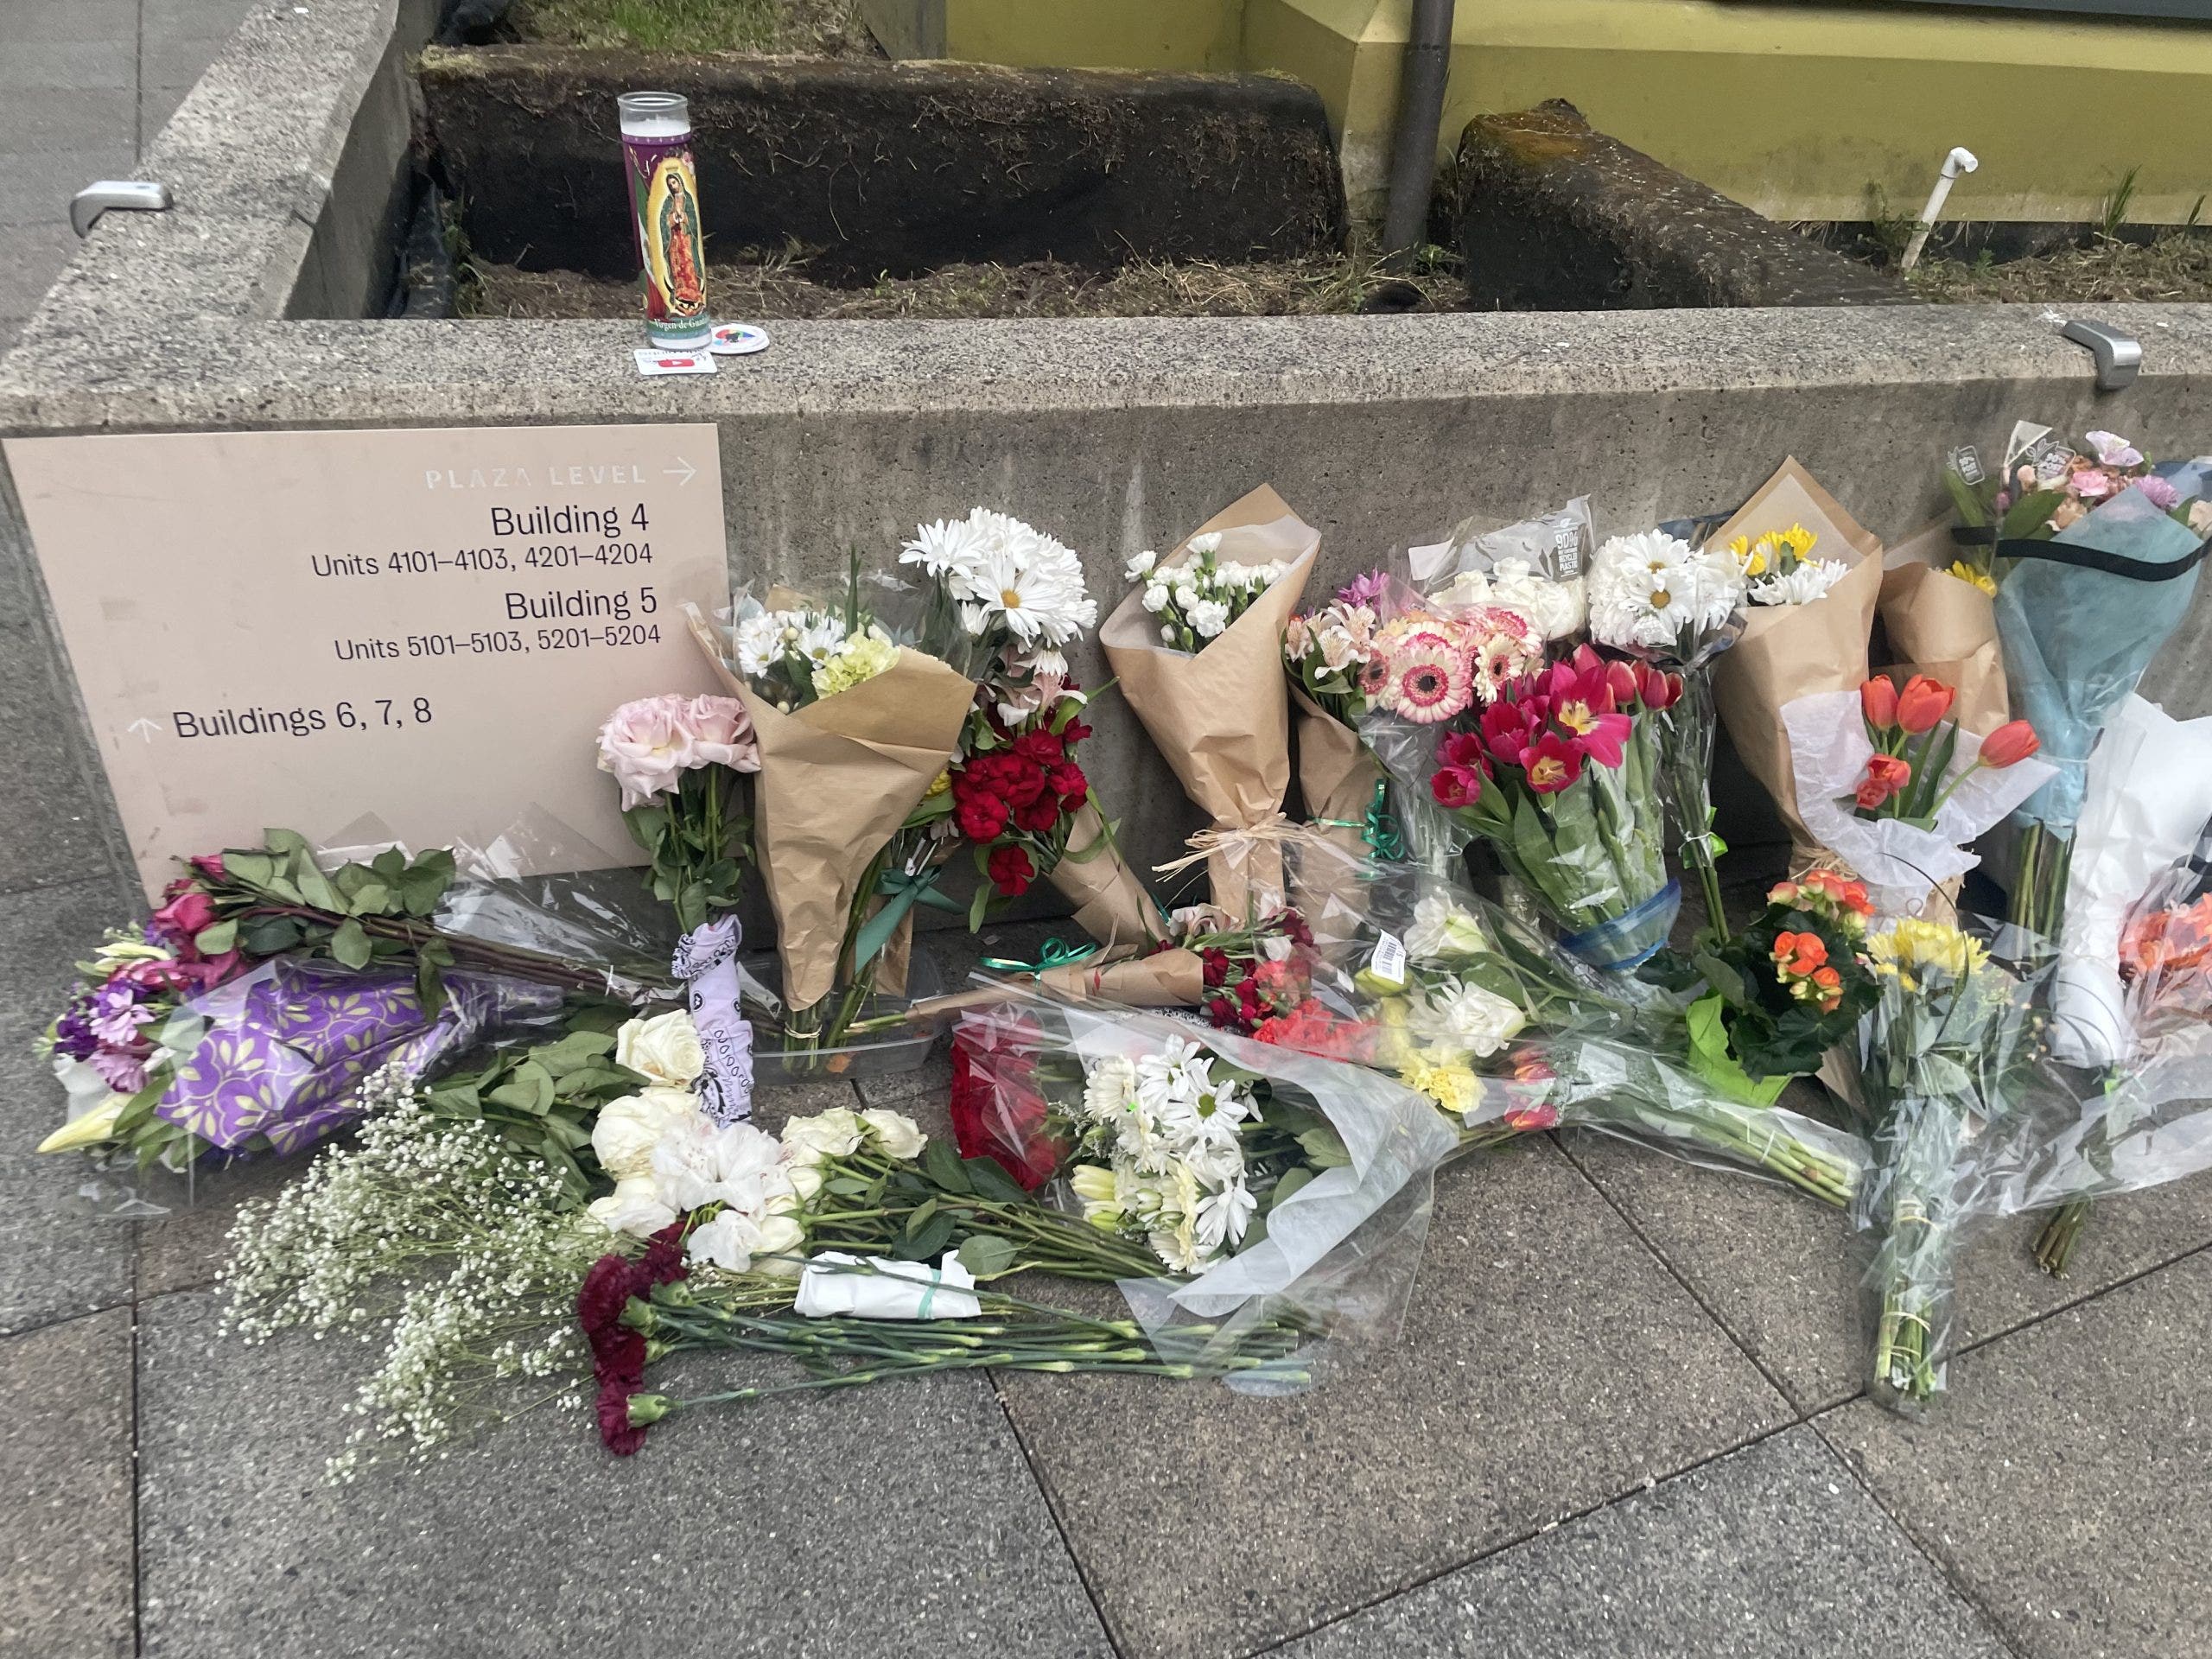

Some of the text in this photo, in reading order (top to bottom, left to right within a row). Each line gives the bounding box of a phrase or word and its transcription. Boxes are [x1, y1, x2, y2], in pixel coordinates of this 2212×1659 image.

[654, 318, 677, 332] Virgen
[679, 320, 688, 329] de
[425, 465, 646, 490] PLAZA LEVEL
[491, 503, 649, 538] Building 4
[1555, 531, 1579, 550] 90%
[312, 554, 379, 576] Units
[505, 587, 658, 620] Building 5
[334, 638, 399, 660] Units
[173, 696, 432, 738] Buildings 6, 7, 8
